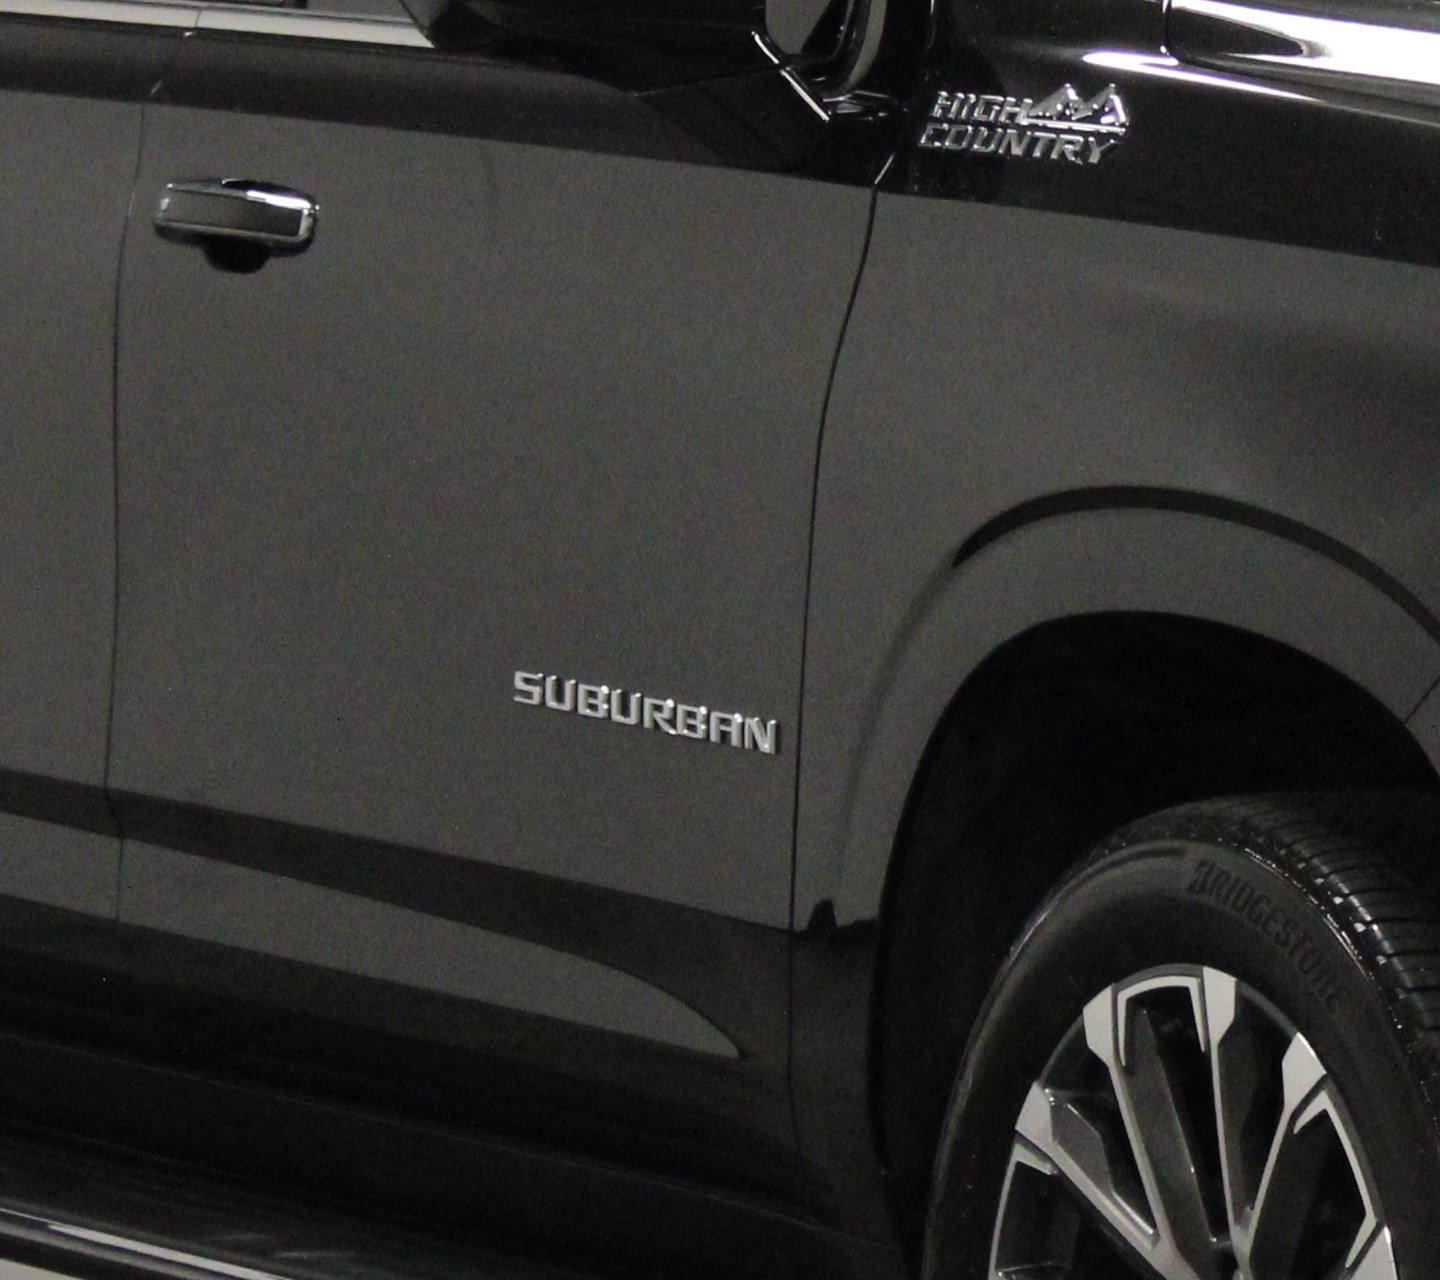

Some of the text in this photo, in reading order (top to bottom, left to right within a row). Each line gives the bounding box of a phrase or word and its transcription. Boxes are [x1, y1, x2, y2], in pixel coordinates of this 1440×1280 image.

[931, 90, 1034, 124] HIGH
[918, 122, 1120, 165] COUNTRY
[513, 670, 777, 755] SUBURBAN
